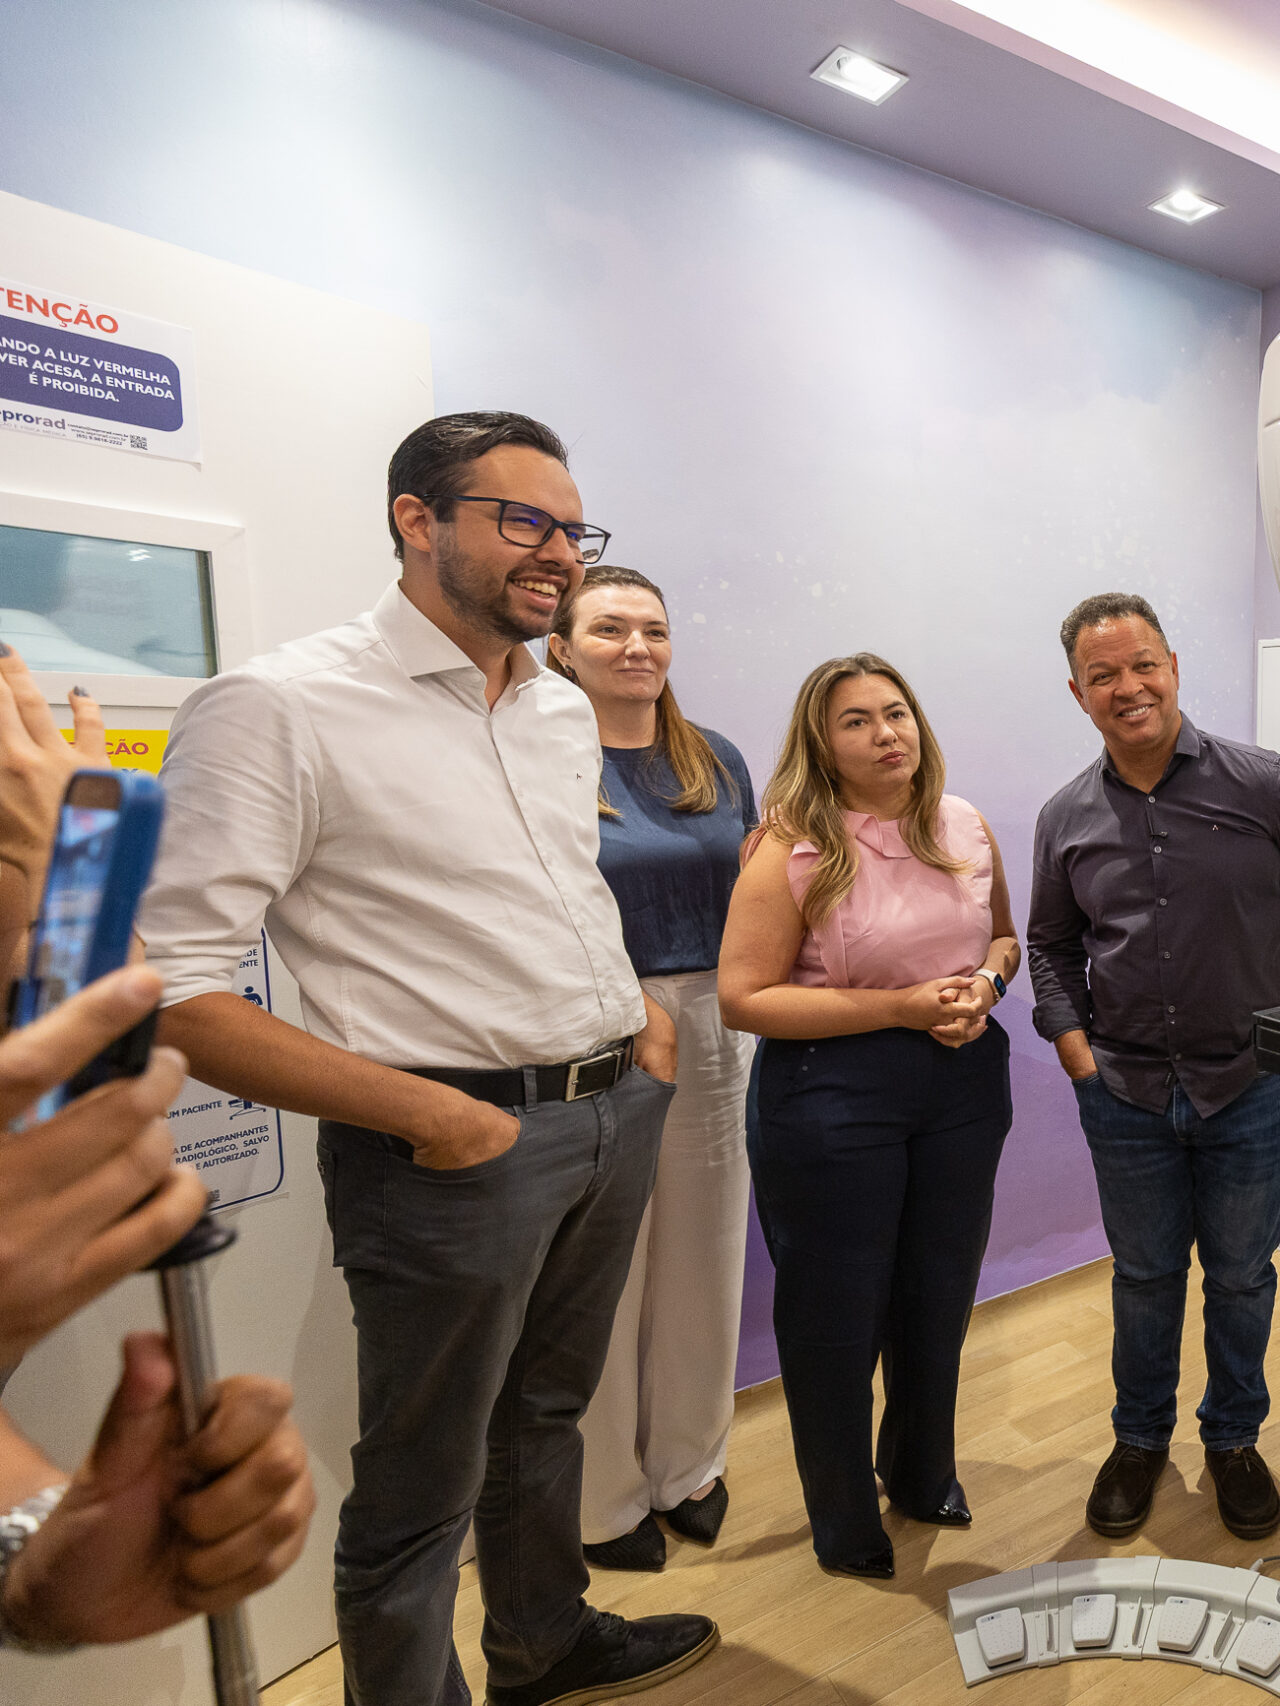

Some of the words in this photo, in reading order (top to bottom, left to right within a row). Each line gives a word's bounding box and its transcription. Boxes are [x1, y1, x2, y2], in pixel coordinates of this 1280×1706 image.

[0, 287, 119, 334] ENÇÃO
[0, 337, 40, 355] NDO
[44, 348, 57, 360] A
[60, 351, 91, 367] LUZ
[93, 358, 172, 386] VERMELHA
[28, 372, 39, 385] É
[42, 376, 120, 402] PROIBIDA.
[32, 360, 88, 382] ACESA,
[90, 373, 103, 385] A
[106, 376, 175, 400] ENTRADA
[0, 409, 66, 430] prorad
[181, 1100, 222, 1116] PACIENTE
[180, 1143, 193, 1153] DE
[194, 1124, 269, 1150] ACOMPANHANTES
[243, 1135, 270, 1148] SALVO
[202, 1148, 259, 1169] AUTORIZADO.
